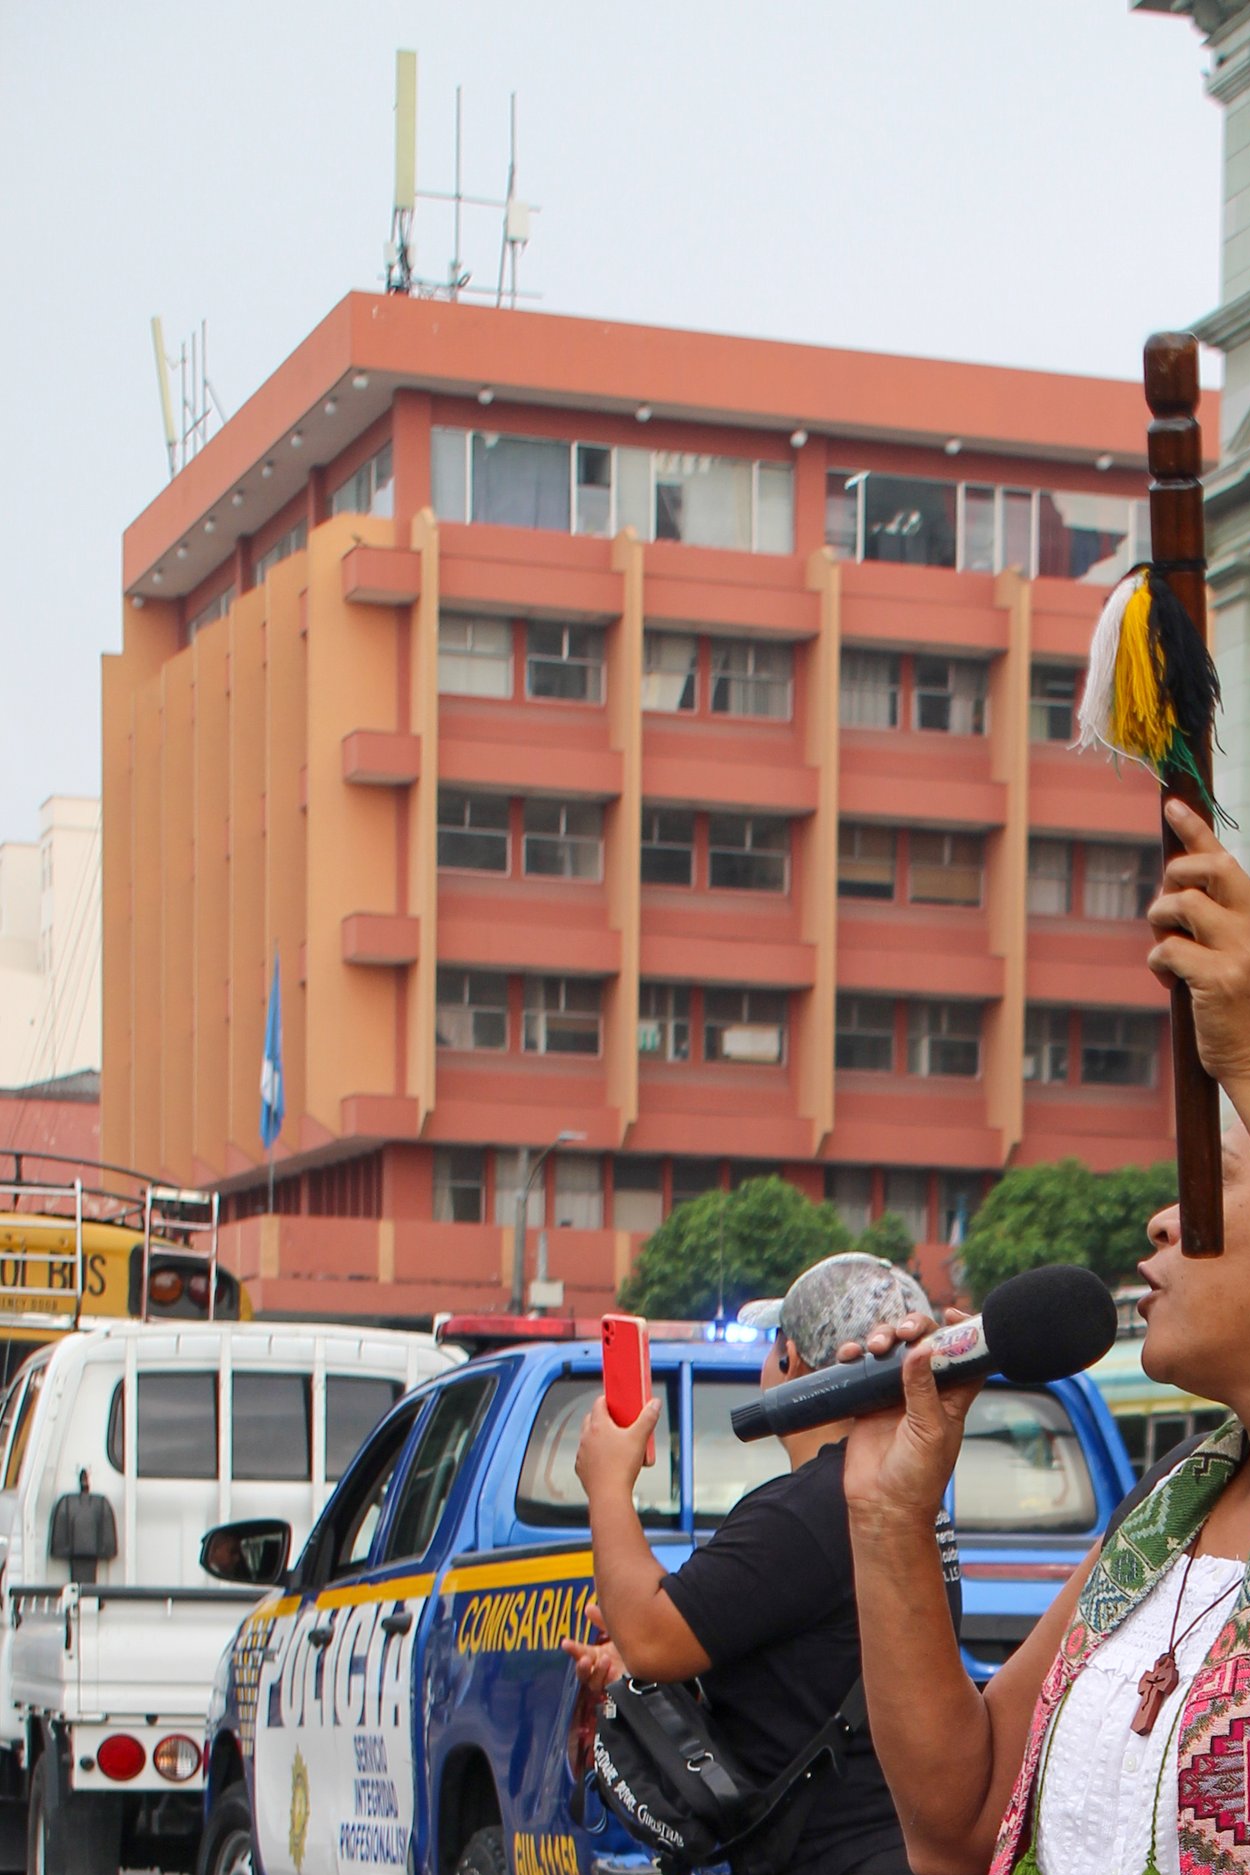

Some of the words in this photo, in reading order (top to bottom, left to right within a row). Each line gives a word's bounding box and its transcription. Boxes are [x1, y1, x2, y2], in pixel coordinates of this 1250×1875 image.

[49, 1250, 106, 1297] BUS
[257, 1597, 427, 1728] POLICIA
[353, 1734, 388, 1774] SERVICIO
[354, 1778, 399, 1819] INTEGRIDAD
